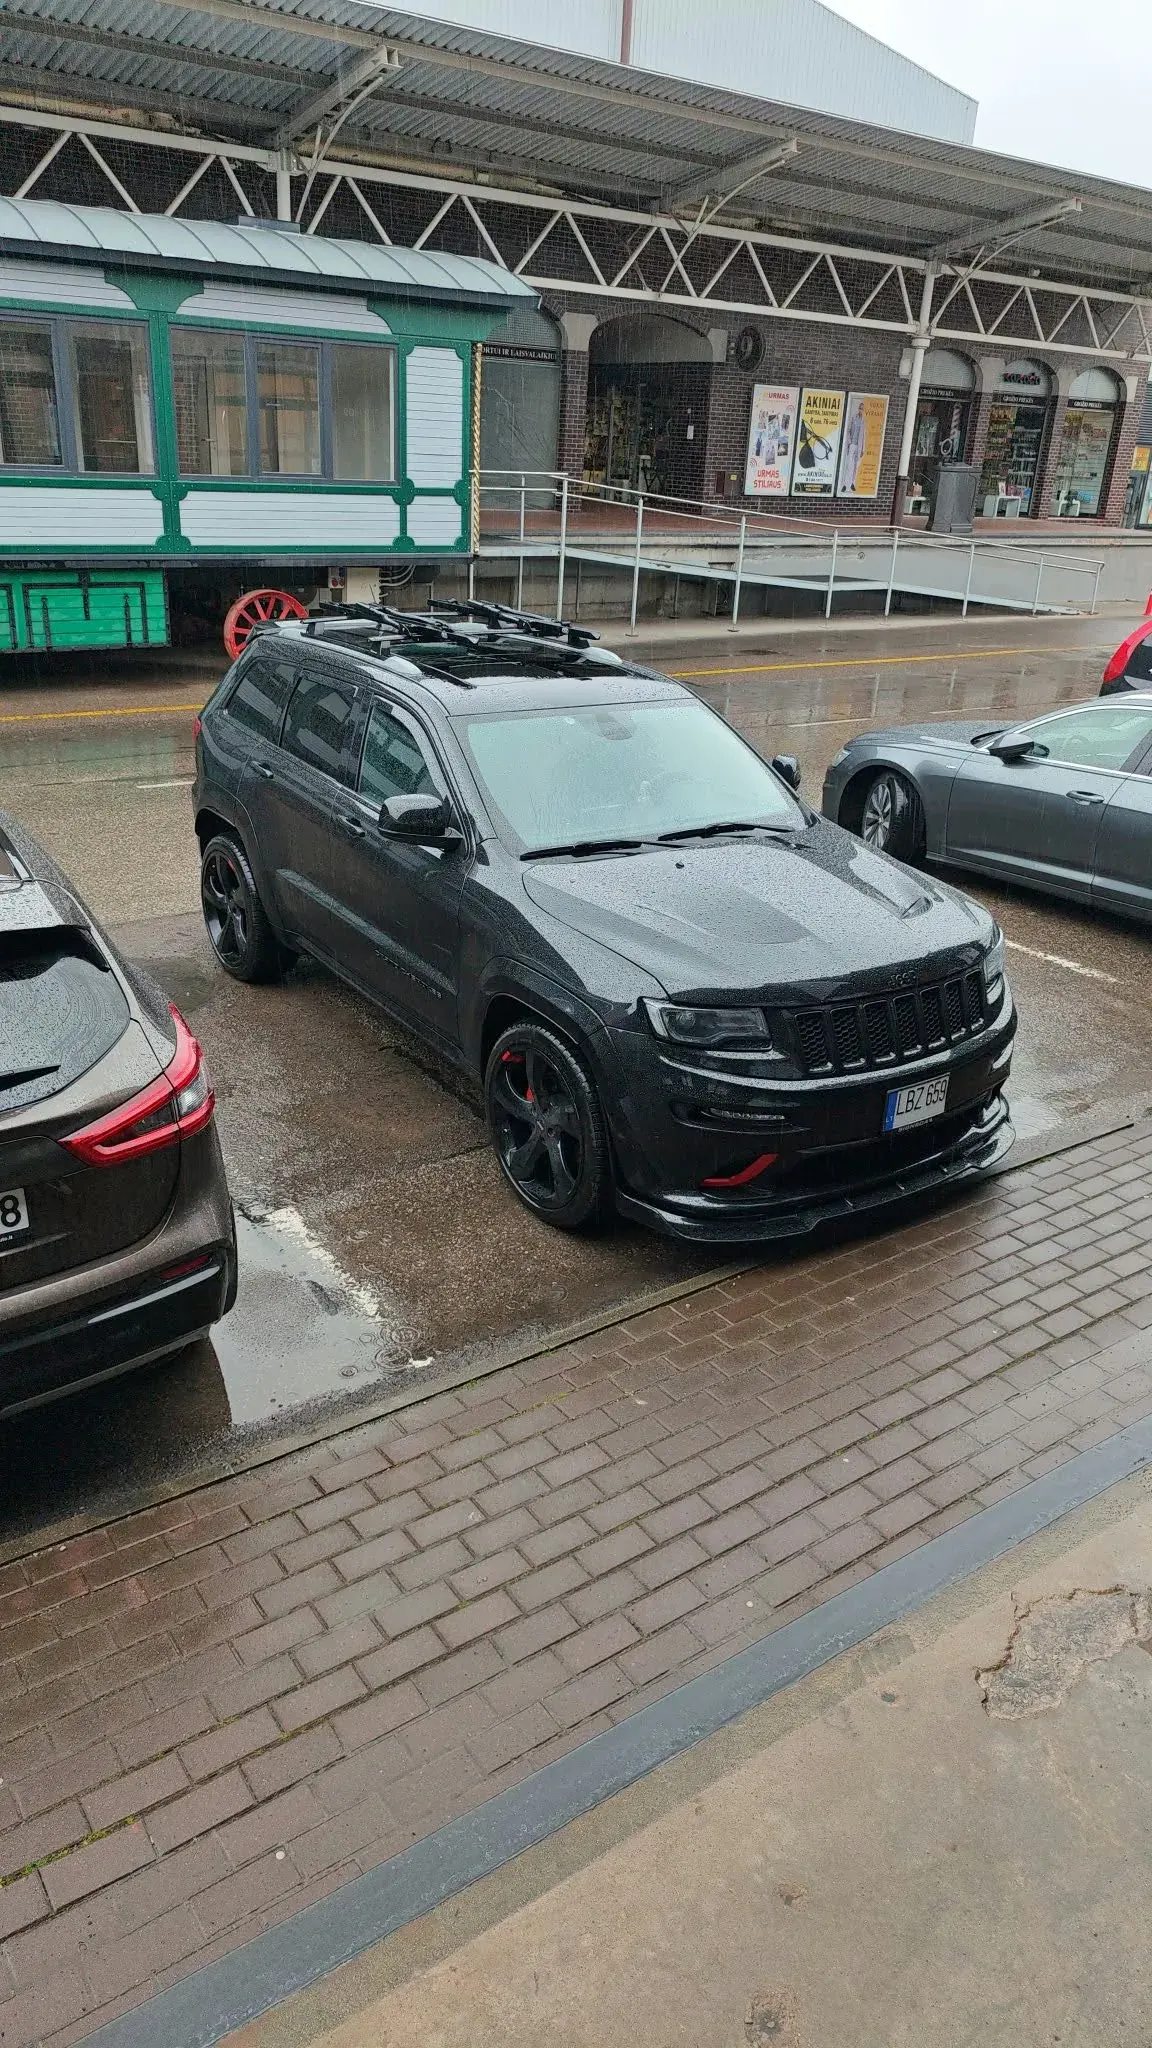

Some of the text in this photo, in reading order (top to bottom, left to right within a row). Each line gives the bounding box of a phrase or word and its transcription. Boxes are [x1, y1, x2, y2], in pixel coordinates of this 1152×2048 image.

[472, 344, 501, 355] SORTUI
[768, 392, 790, 400] URMAS
[805, 395, 841, 410] AKINIAI
[757, 469, 780, 479] URMAS
[896, 1079, 948, 1116] LBZ 659
[885, 1115, 894, 1123] LT
